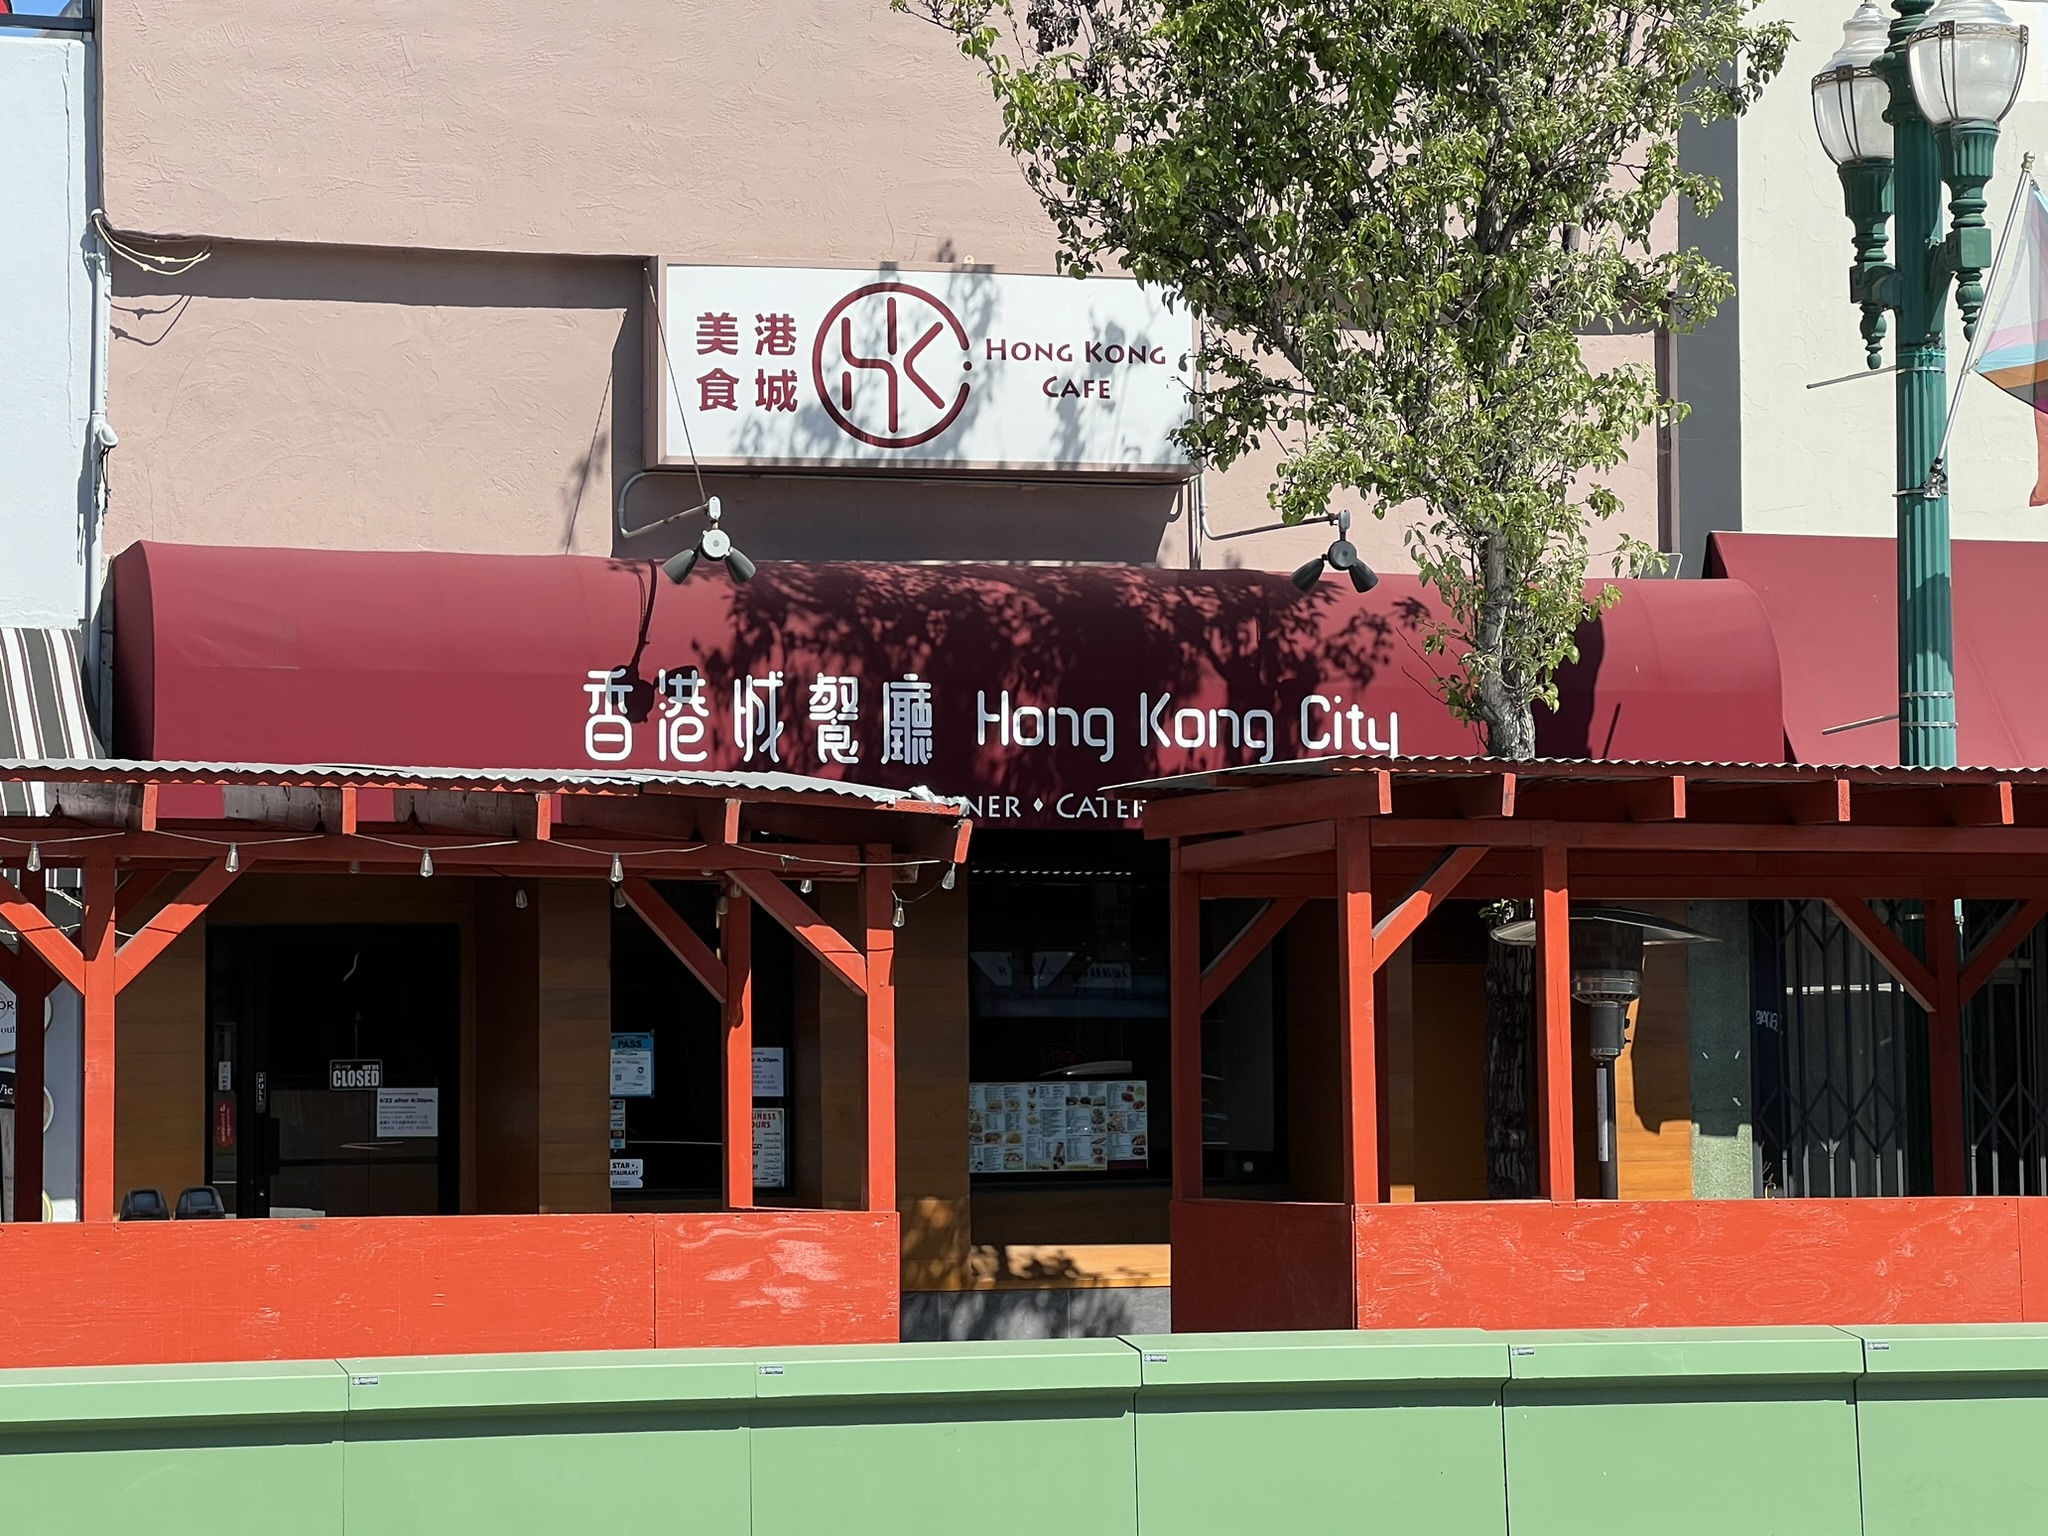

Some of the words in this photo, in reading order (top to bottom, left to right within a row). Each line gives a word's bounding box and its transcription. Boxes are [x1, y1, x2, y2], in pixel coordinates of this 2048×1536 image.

[985, 337, 1073, 362] HONG
[1085, 341, 1166, 365] KONG
[1042, 375, 1111, 399] CAFE
[977, 690, 1114, 762] Hong
[1140, 692, 1274, 764] Kong
[1300, 694, 1398, 760] City
[965, 795, 1022, 818] NER
[617, 1040, 642, 1048] PASS
[332, 1070, 380, 1087] CLOSED
[752, 1121, 771, 1129] URS
